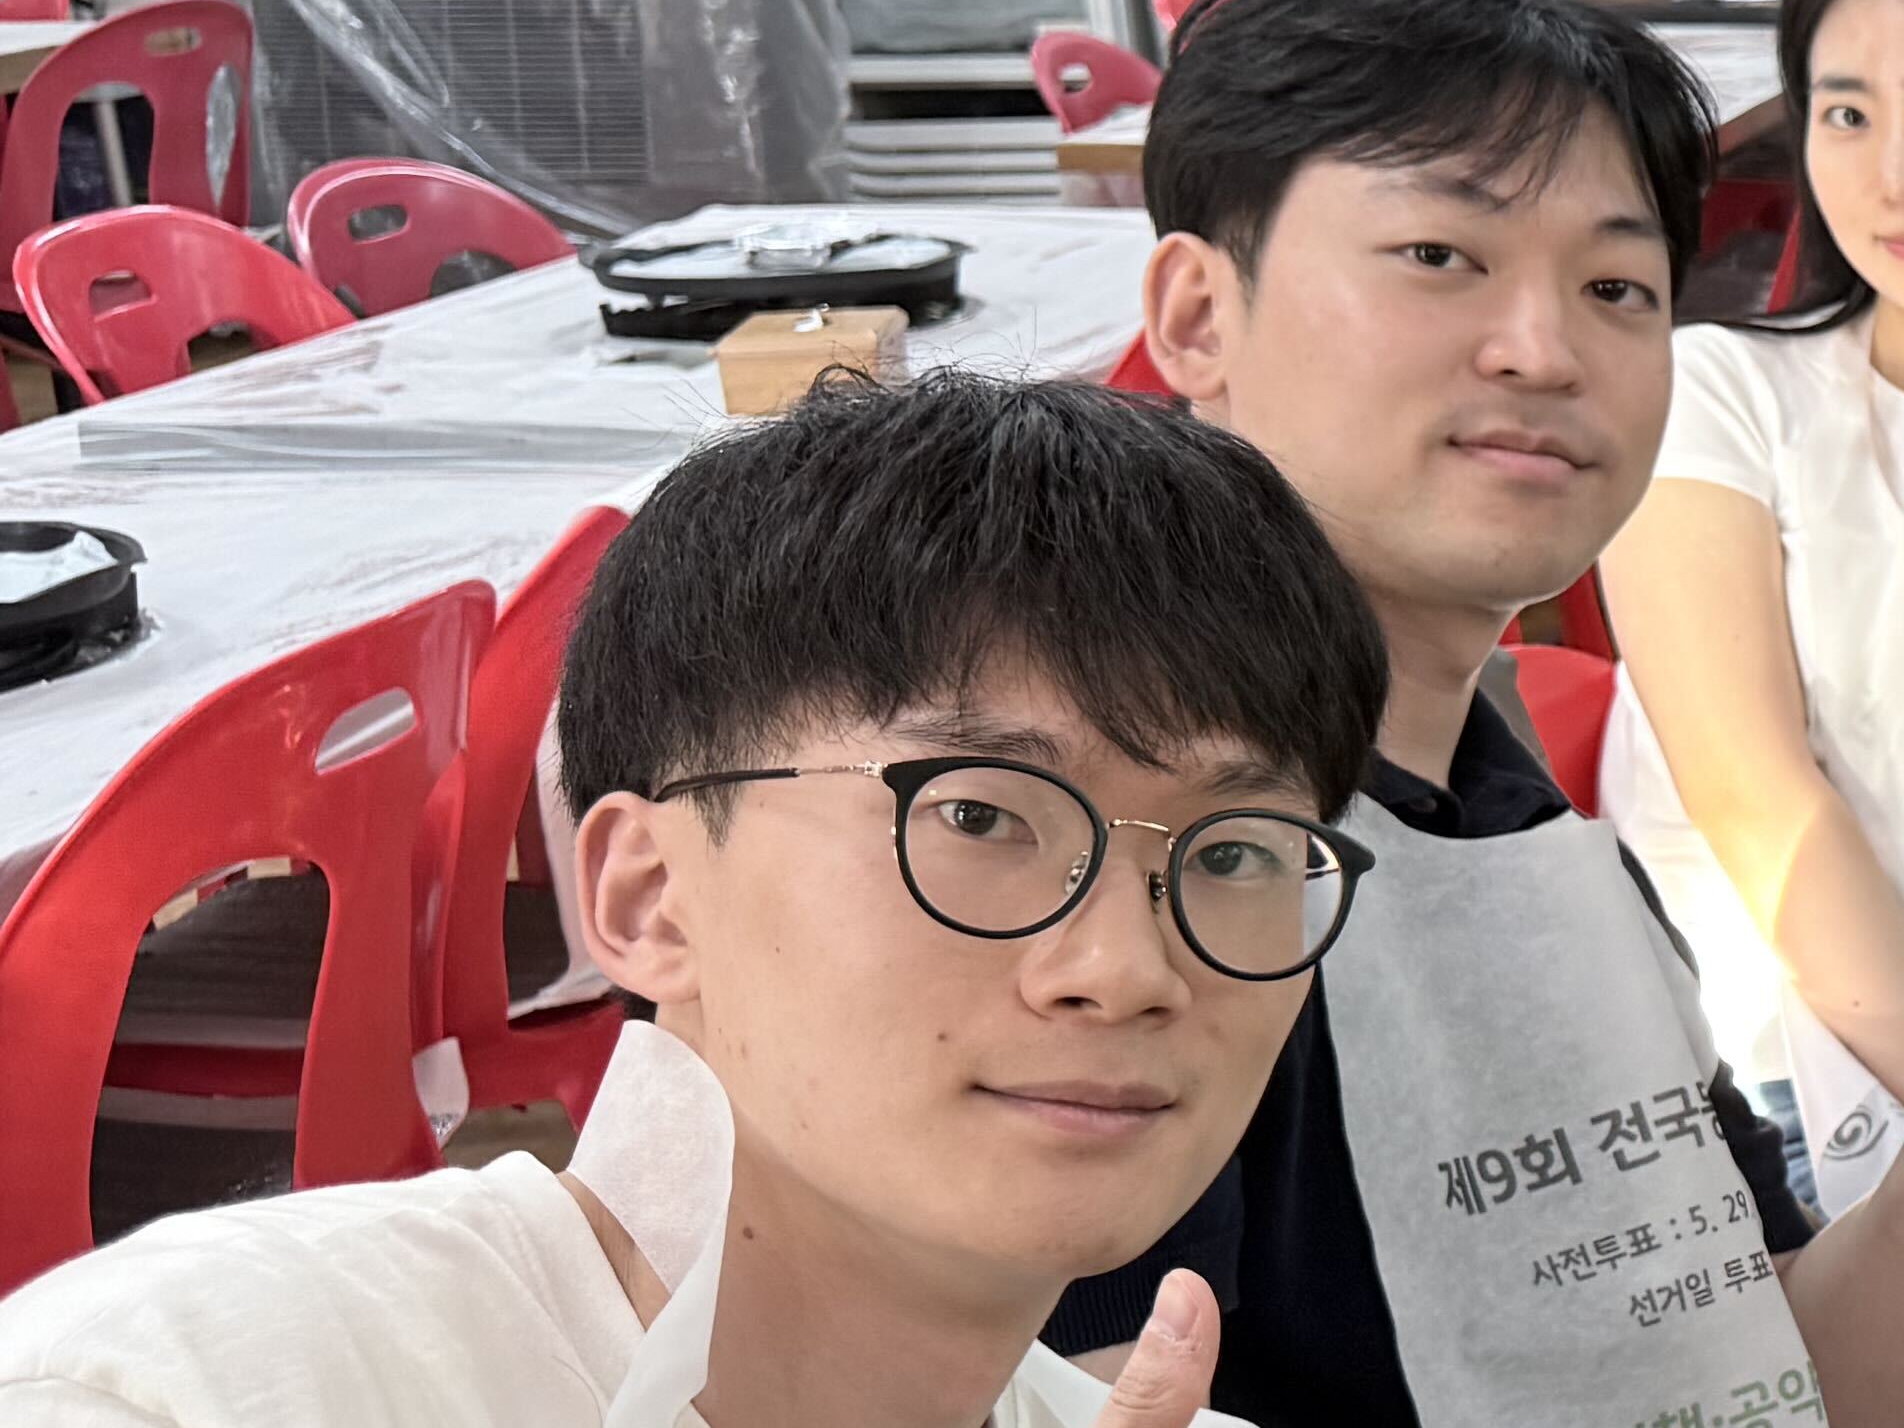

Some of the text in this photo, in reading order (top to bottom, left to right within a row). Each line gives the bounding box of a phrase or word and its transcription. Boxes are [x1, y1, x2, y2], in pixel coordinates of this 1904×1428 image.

[1438, 1127, 1582, 1216] 제9회
[1532, 1222, 1662, 1287] 사전투표
[1629, 1250, 1774, 1328] 선거일 투표
